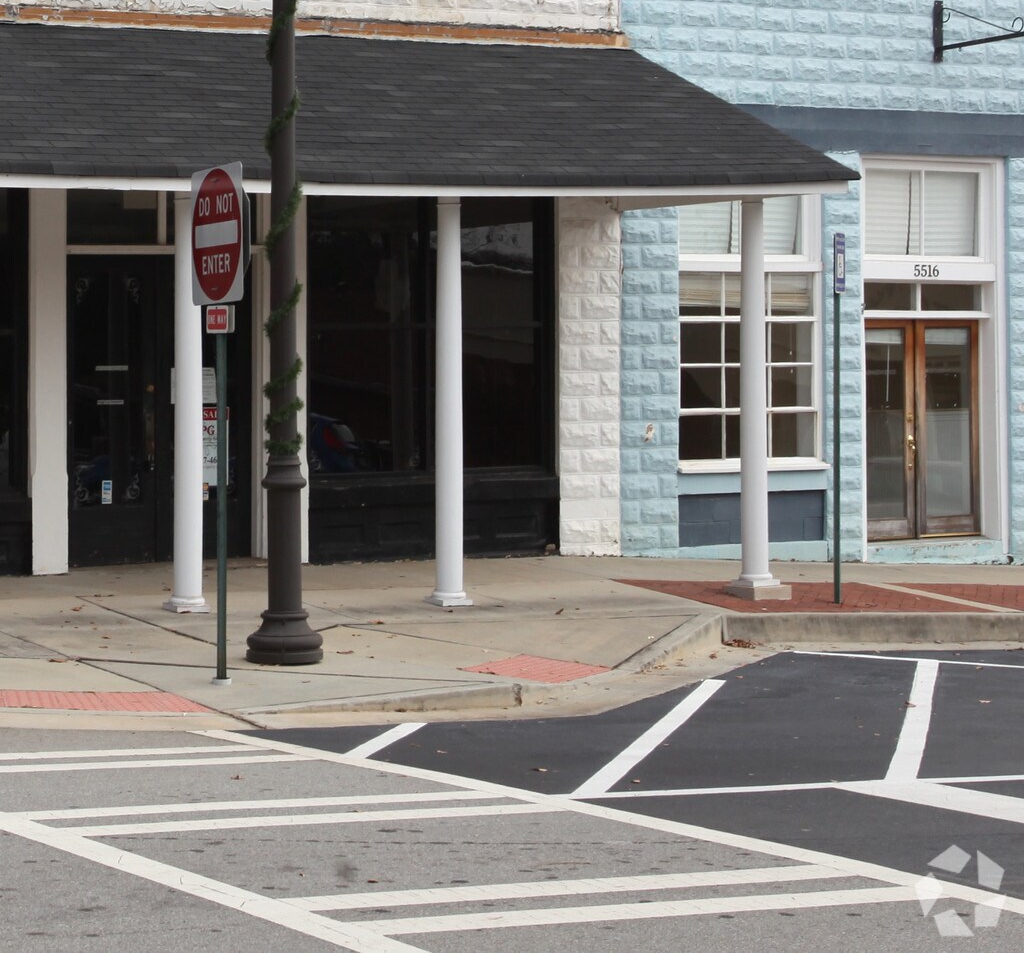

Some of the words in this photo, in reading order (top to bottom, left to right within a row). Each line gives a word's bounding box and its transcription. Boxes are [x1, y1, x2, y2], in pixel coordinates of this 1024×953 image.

[199, 197, 210, 217] DO
[216, 193, 233, 214] NOT
[202, 253, 230, 275] ENTER
[914, 264, 940, 277] 5516
[207, 315, 216, 325] ONE
[217, 315, 226, 325] WAY
